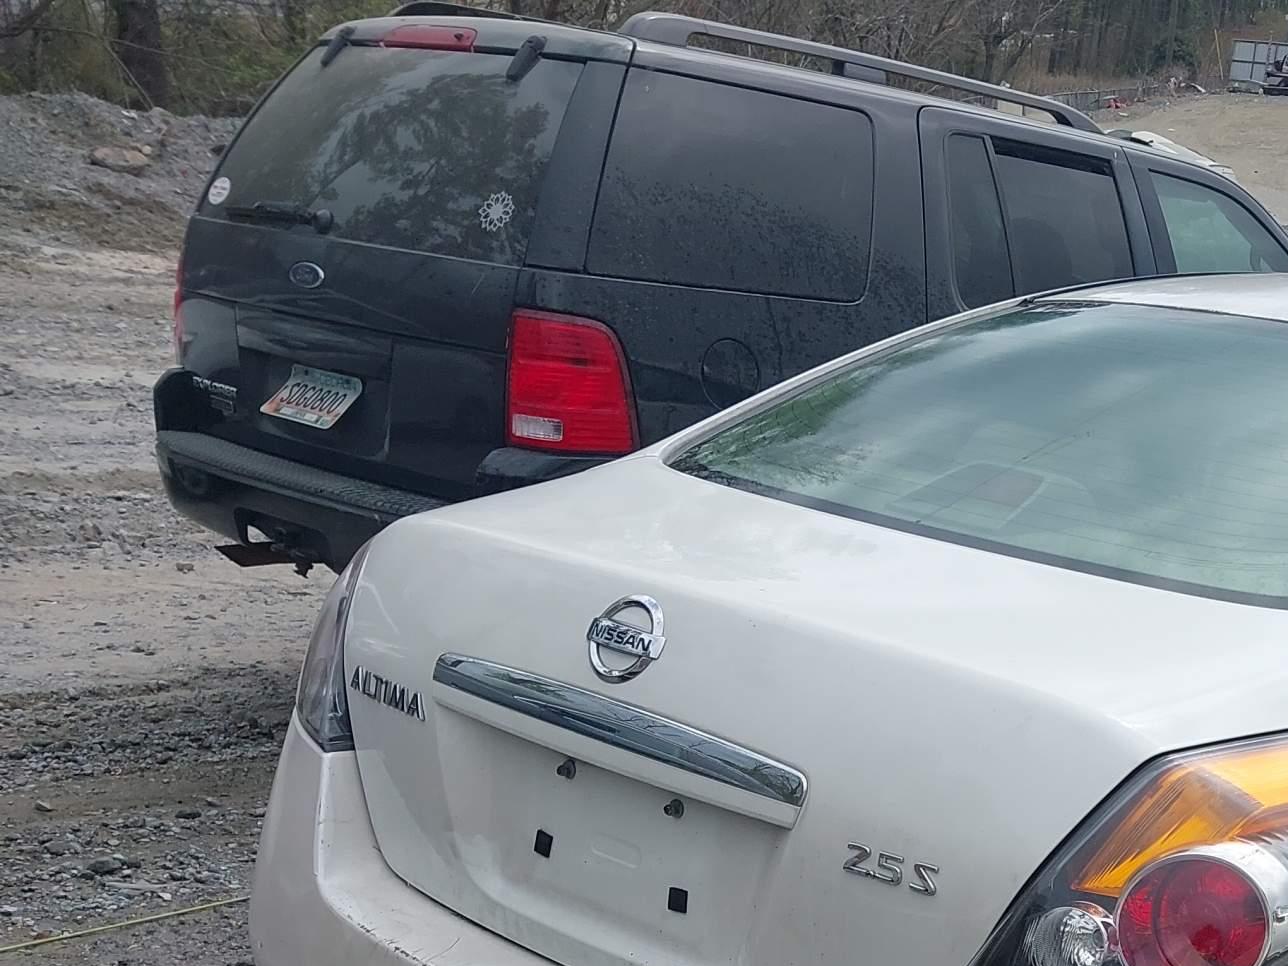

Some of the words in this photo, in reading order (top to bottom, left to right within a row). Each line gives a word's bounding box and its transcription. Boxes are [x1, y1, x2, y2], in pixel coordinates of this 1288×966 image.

[591, 622, 652, 652] NISSAN
[350, 665, 426, 721] ALTIMA
[908, 861, 940, 896] S
